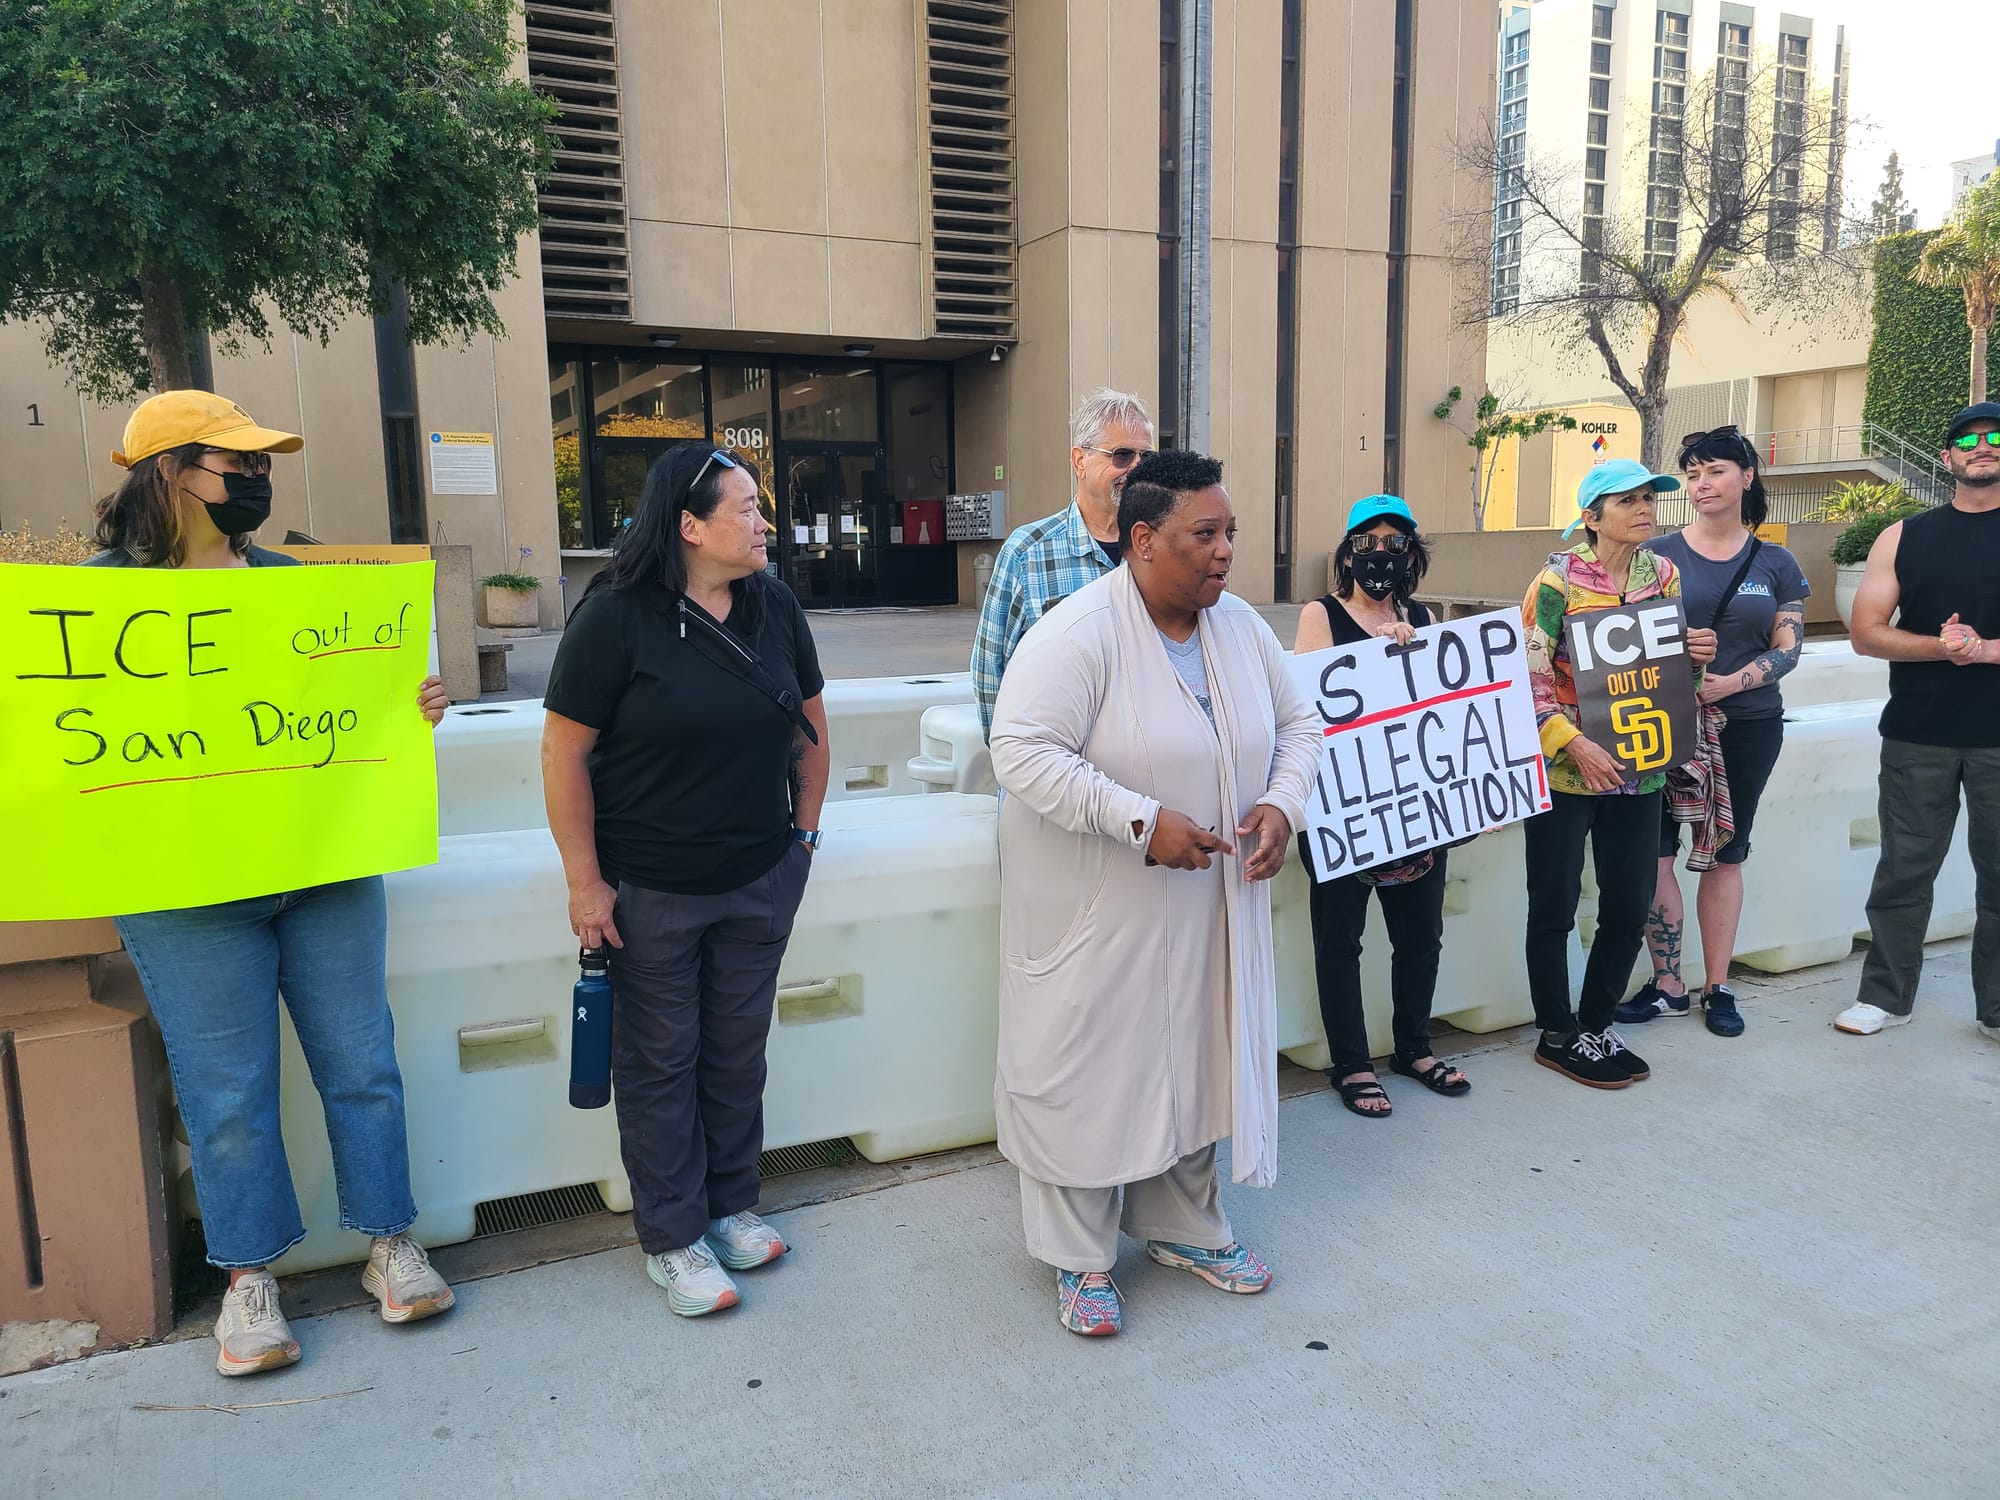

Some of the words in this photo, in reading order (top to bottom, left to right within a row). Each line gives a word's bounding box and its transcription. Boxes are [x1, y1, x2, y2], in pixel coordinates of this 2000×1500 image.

[27, 403, 45, 426] 1
[724, 427, 763, 449] 808
[1581, 422, 1618, 434] KOHLER
[1359, 435, 1368, 451] 1
[356, 557, 391, 565] Justice
[1737, 582, 1769, 594] Guild
[16, 609, 232, 679] ICE
[374, 602, 413, 646] of
[1571, 605, 1684, 672] ICE
[1316, 620, 1517, 725] STOP
[1607, 670, 1638, 696] OUT
[1641, 666, 1661, 691] OF
[55, 707, 207, 766] San
[241, 700, 359, 768] Diego
[1317, 696, 1537, 815] ILLEGAL
[1610, 696, 1673, 772] SD
[1318, 753, 1551, 873] DETENTION!
